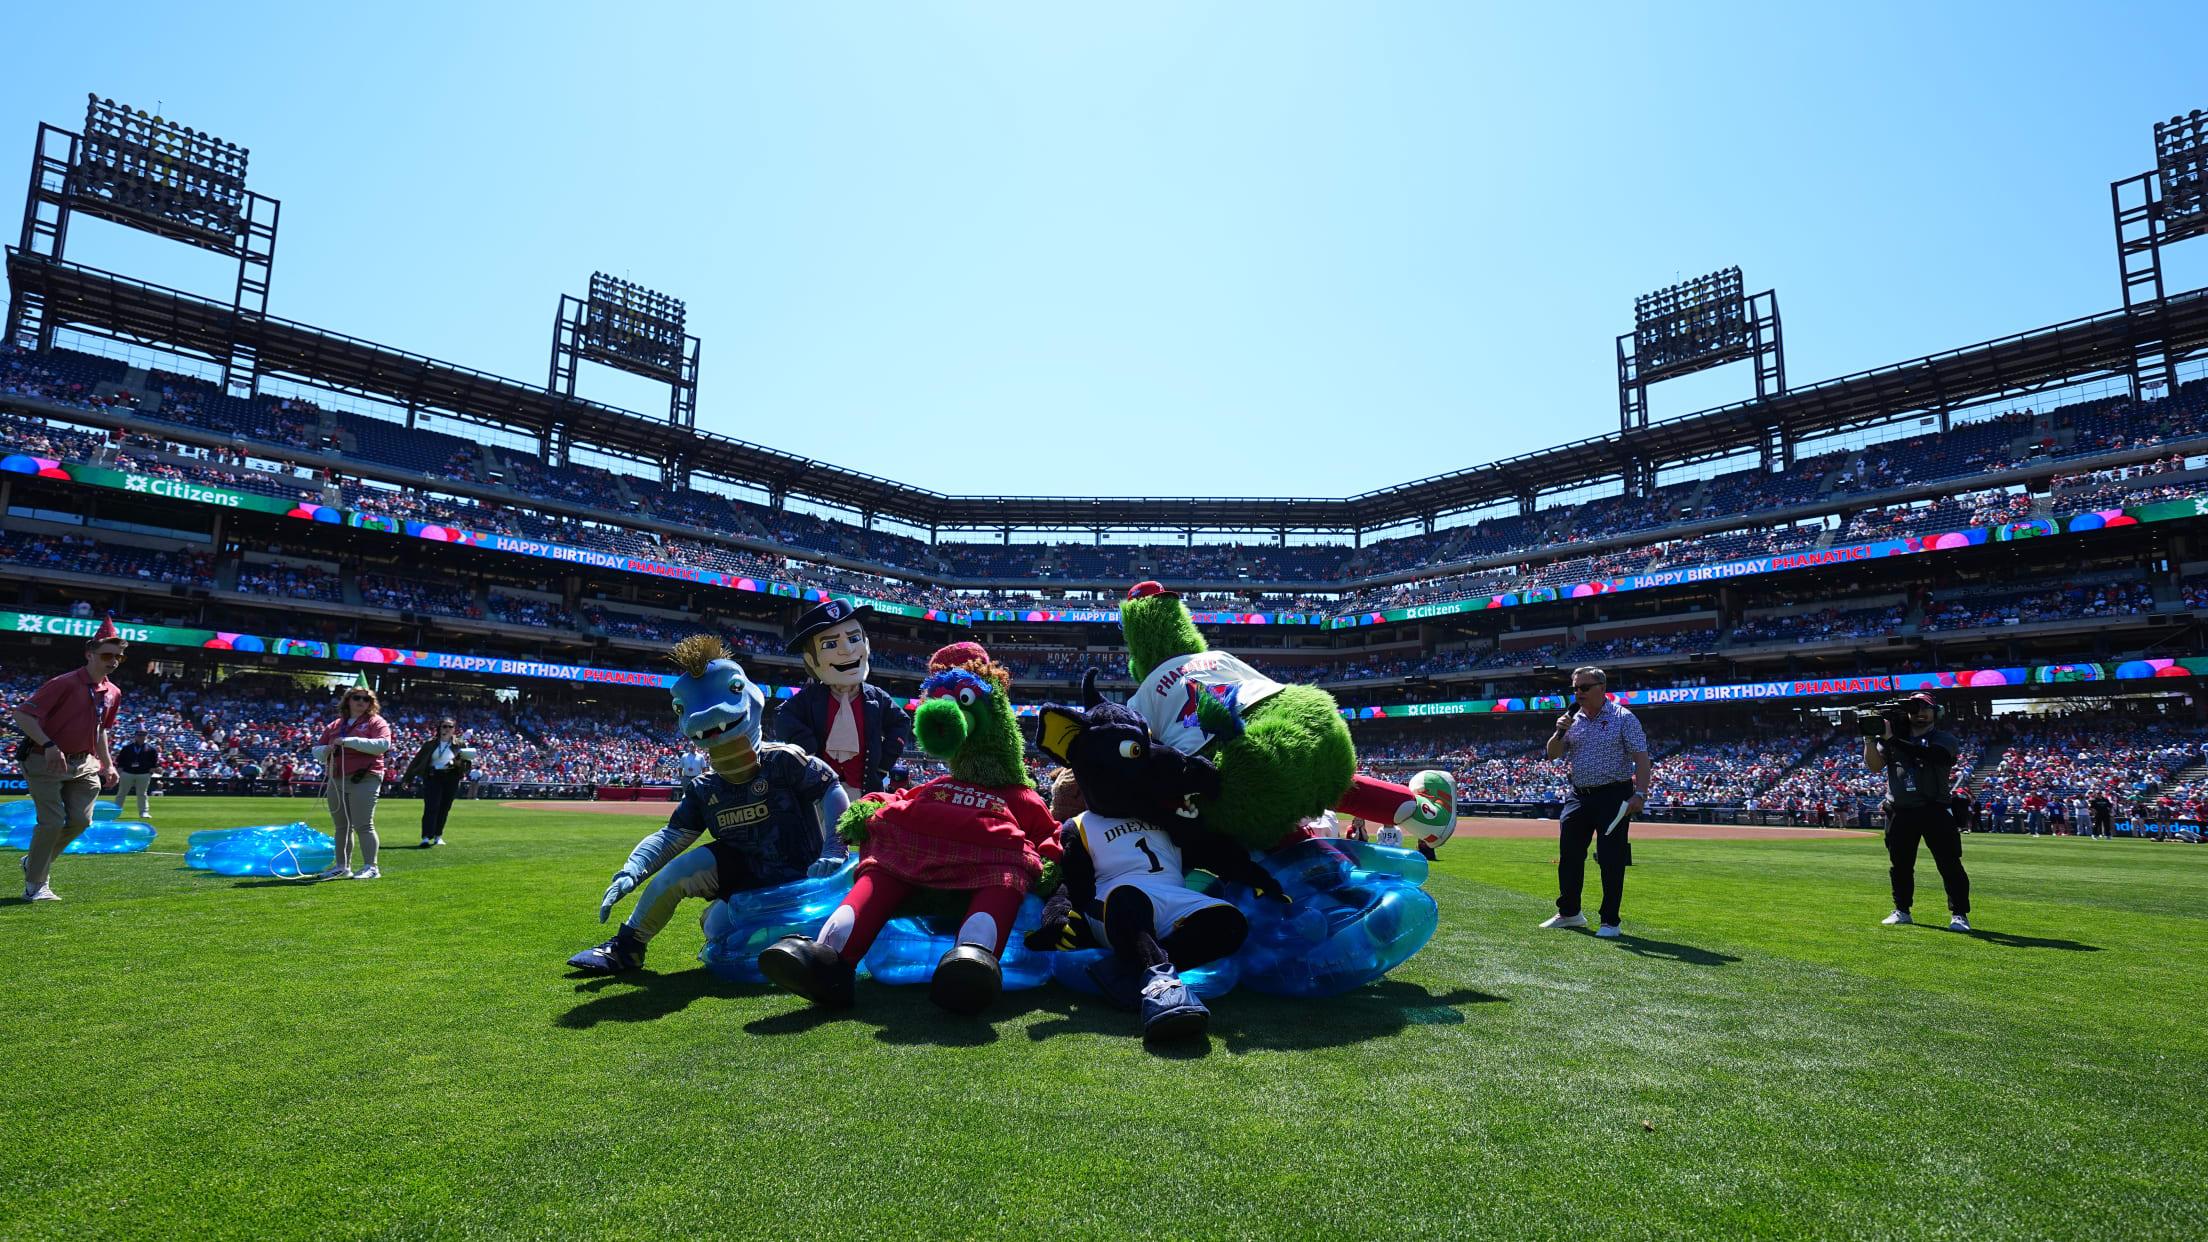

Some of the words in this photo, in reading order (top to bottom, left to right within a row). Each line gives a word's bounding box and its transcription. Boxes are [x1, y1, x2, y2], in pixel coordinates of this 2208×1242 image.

[150, 478, 240, 508] Citizens
[496, 537, 550, 557] HAPPY
[552, 546, 626, 570] BIRTHDAY
[627, 560, 700, 582] PHANATIC!
[1634, 571, 1685, 589] HAPPY
[1687, 559, 1768, 582] BIRTHDAY
[1772, 545, 1871, 570] PHANATIC!
[865, 600, 903, 615] Citizens
[1072, 612, 1107, 622] HAPPY
[1191, 614, 1217, 624] ATIC!
[1417, 602, 1462, 618] Citizens
[46, 616, 150, 641] Citins
[439, 655, 497, 672] HAPPY
[500, 660, 580, 680] BIRTHDAY
[583, 669, 662, 687] PHANATIC!
[1155, 658, 1218, 697] PHANATIC
[1647, 687, 1699, 703] HAPPY
[1704, 682, 1790, 700] BIRTHDAY
[1794, 676, 1901, 695] PHANATIC!
[1418, 702, 1465, 716] Citizens
[951, 792, 988, 809] MOM
[716, 803, 769, 828] BIMBO
[1104, 819, 1162, 843] DREXE
[1134, 836, 1165, 874] 1
